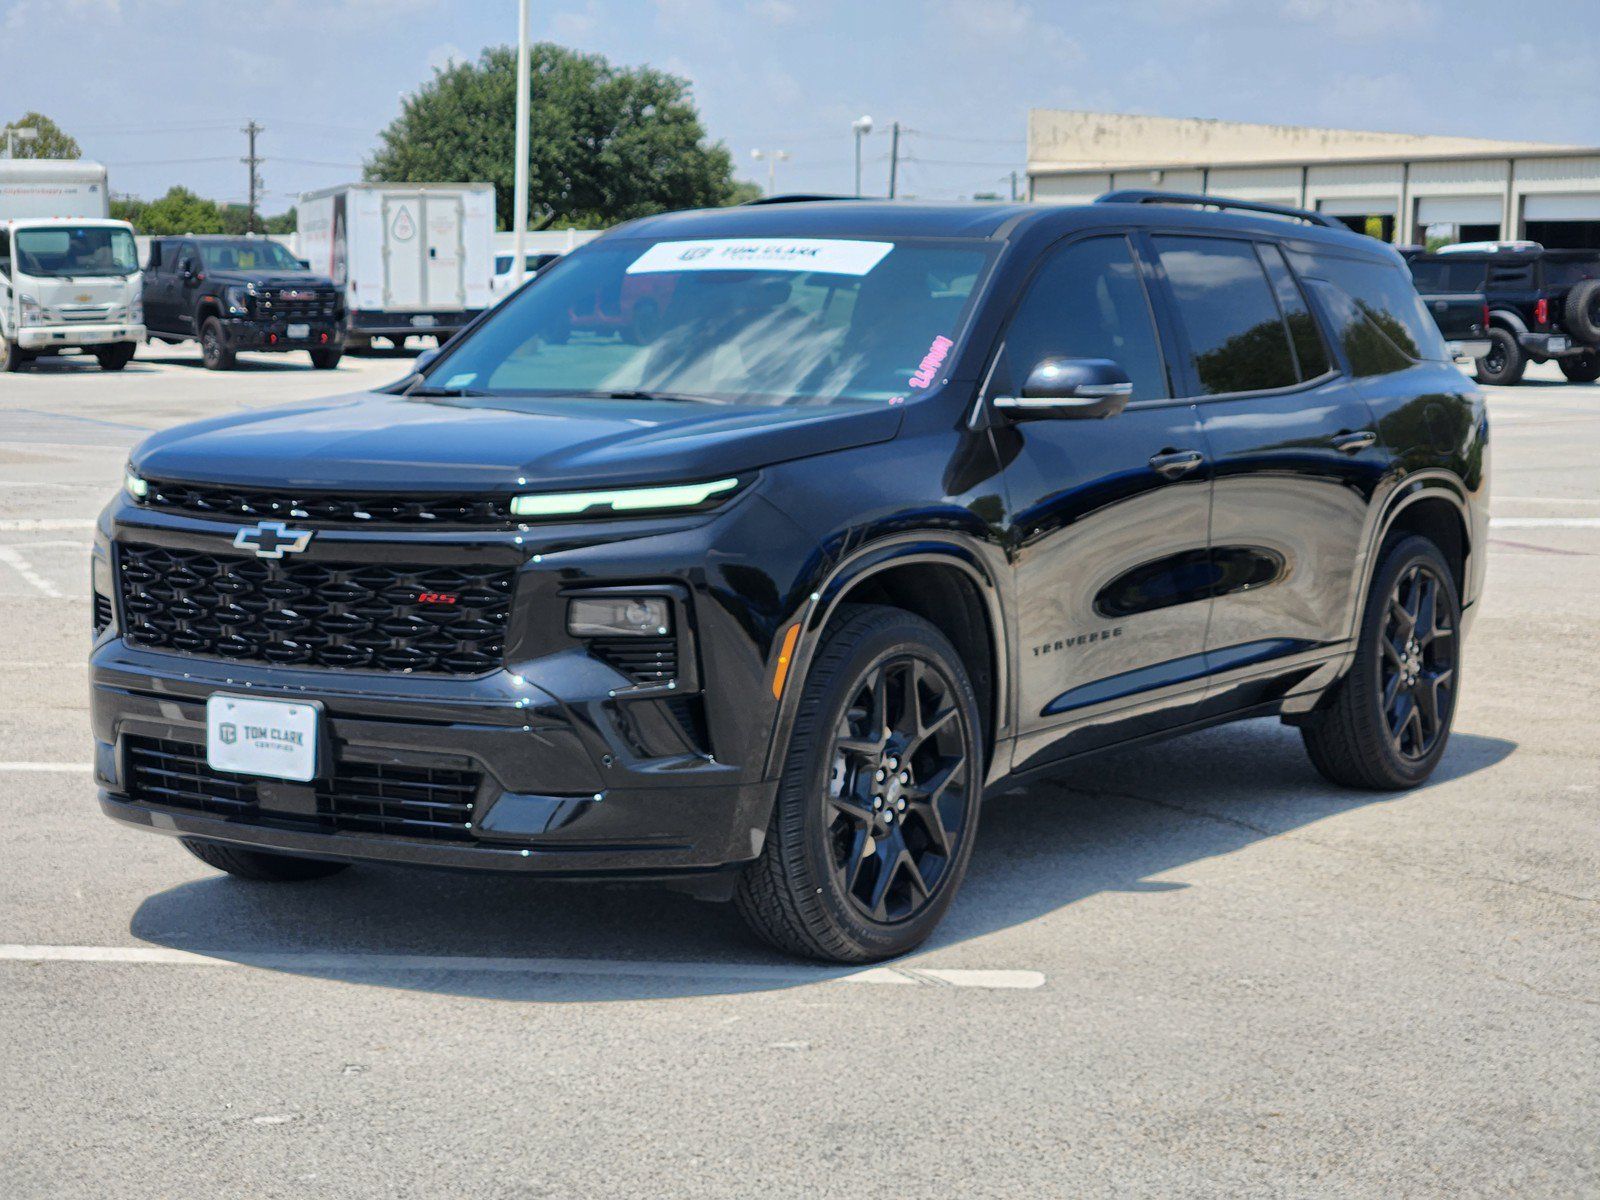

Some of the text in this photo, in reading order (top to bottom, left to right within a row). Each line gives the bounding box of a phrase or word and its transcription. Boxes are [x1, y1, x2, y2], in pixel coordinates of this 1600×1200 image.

[1032, 626, 1122, 656] TRAVERSE
[244, 726, 303, 746] TOM CLARK
